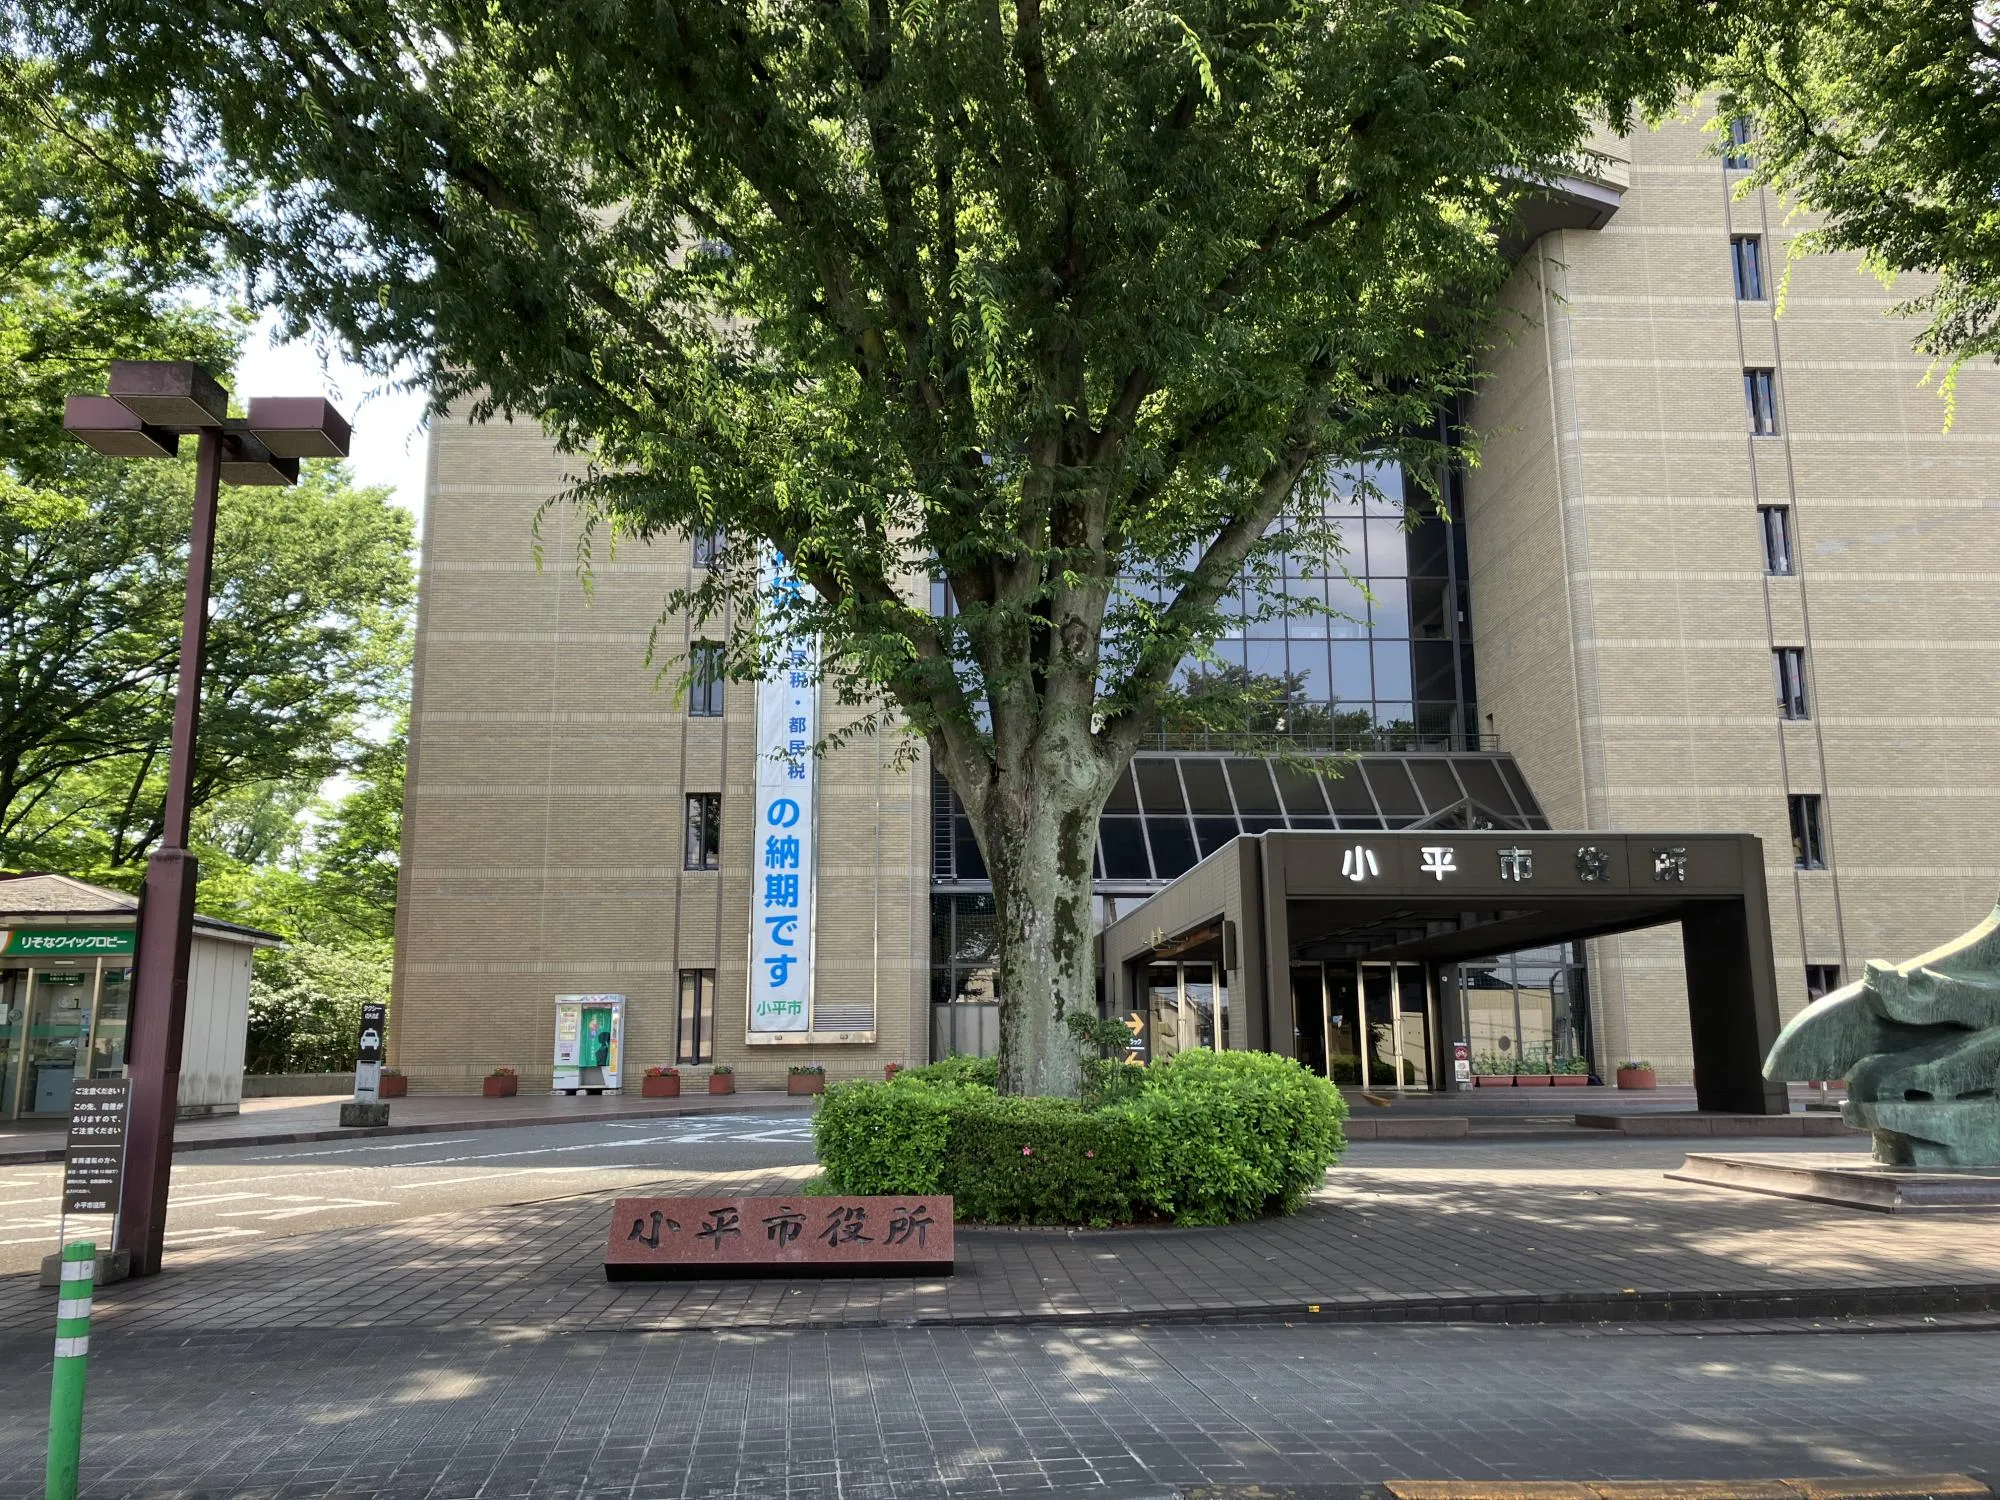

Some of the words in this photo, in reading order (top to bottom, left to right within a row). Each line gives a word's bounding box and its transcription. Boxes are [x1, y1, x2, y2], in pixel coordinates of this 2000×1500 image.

[788, 634, 807, 780] 民税・都民税
[1341, 845, 1687, 882] 小平市役所
[764, 798, 800, 988] の納期です
[21, 936, 127, 949] りそなクイックロビー
[756, 1000, 802, 1016] 小平市
[71, 1127, 121, 1135] ご注意ください
[72, 1115, 121, 1123] ありますので、
[627, 1205, 936, 1250] 小平市役所
